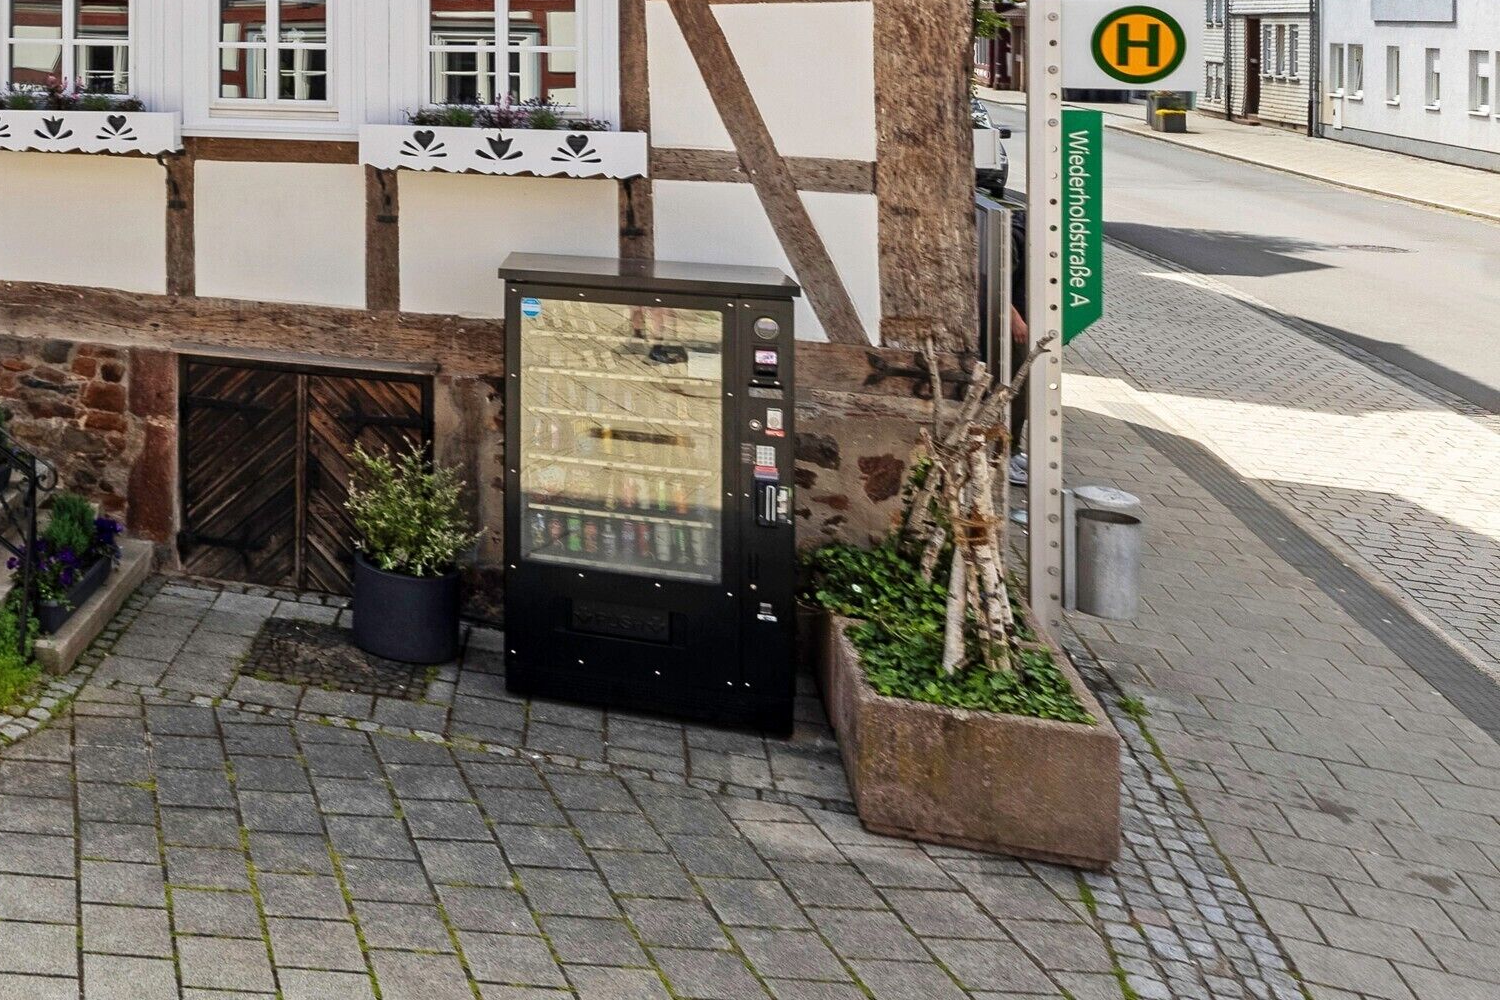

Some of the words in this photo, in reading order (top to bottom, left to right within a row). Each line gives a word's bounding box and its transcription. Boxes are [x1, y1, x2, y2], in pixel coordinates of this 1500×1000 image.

[1117, 23, 1160, 67] H
[1068, 130, 1092, 288] Wiederholdstraße
[1069, 292, 1091, 307] A
